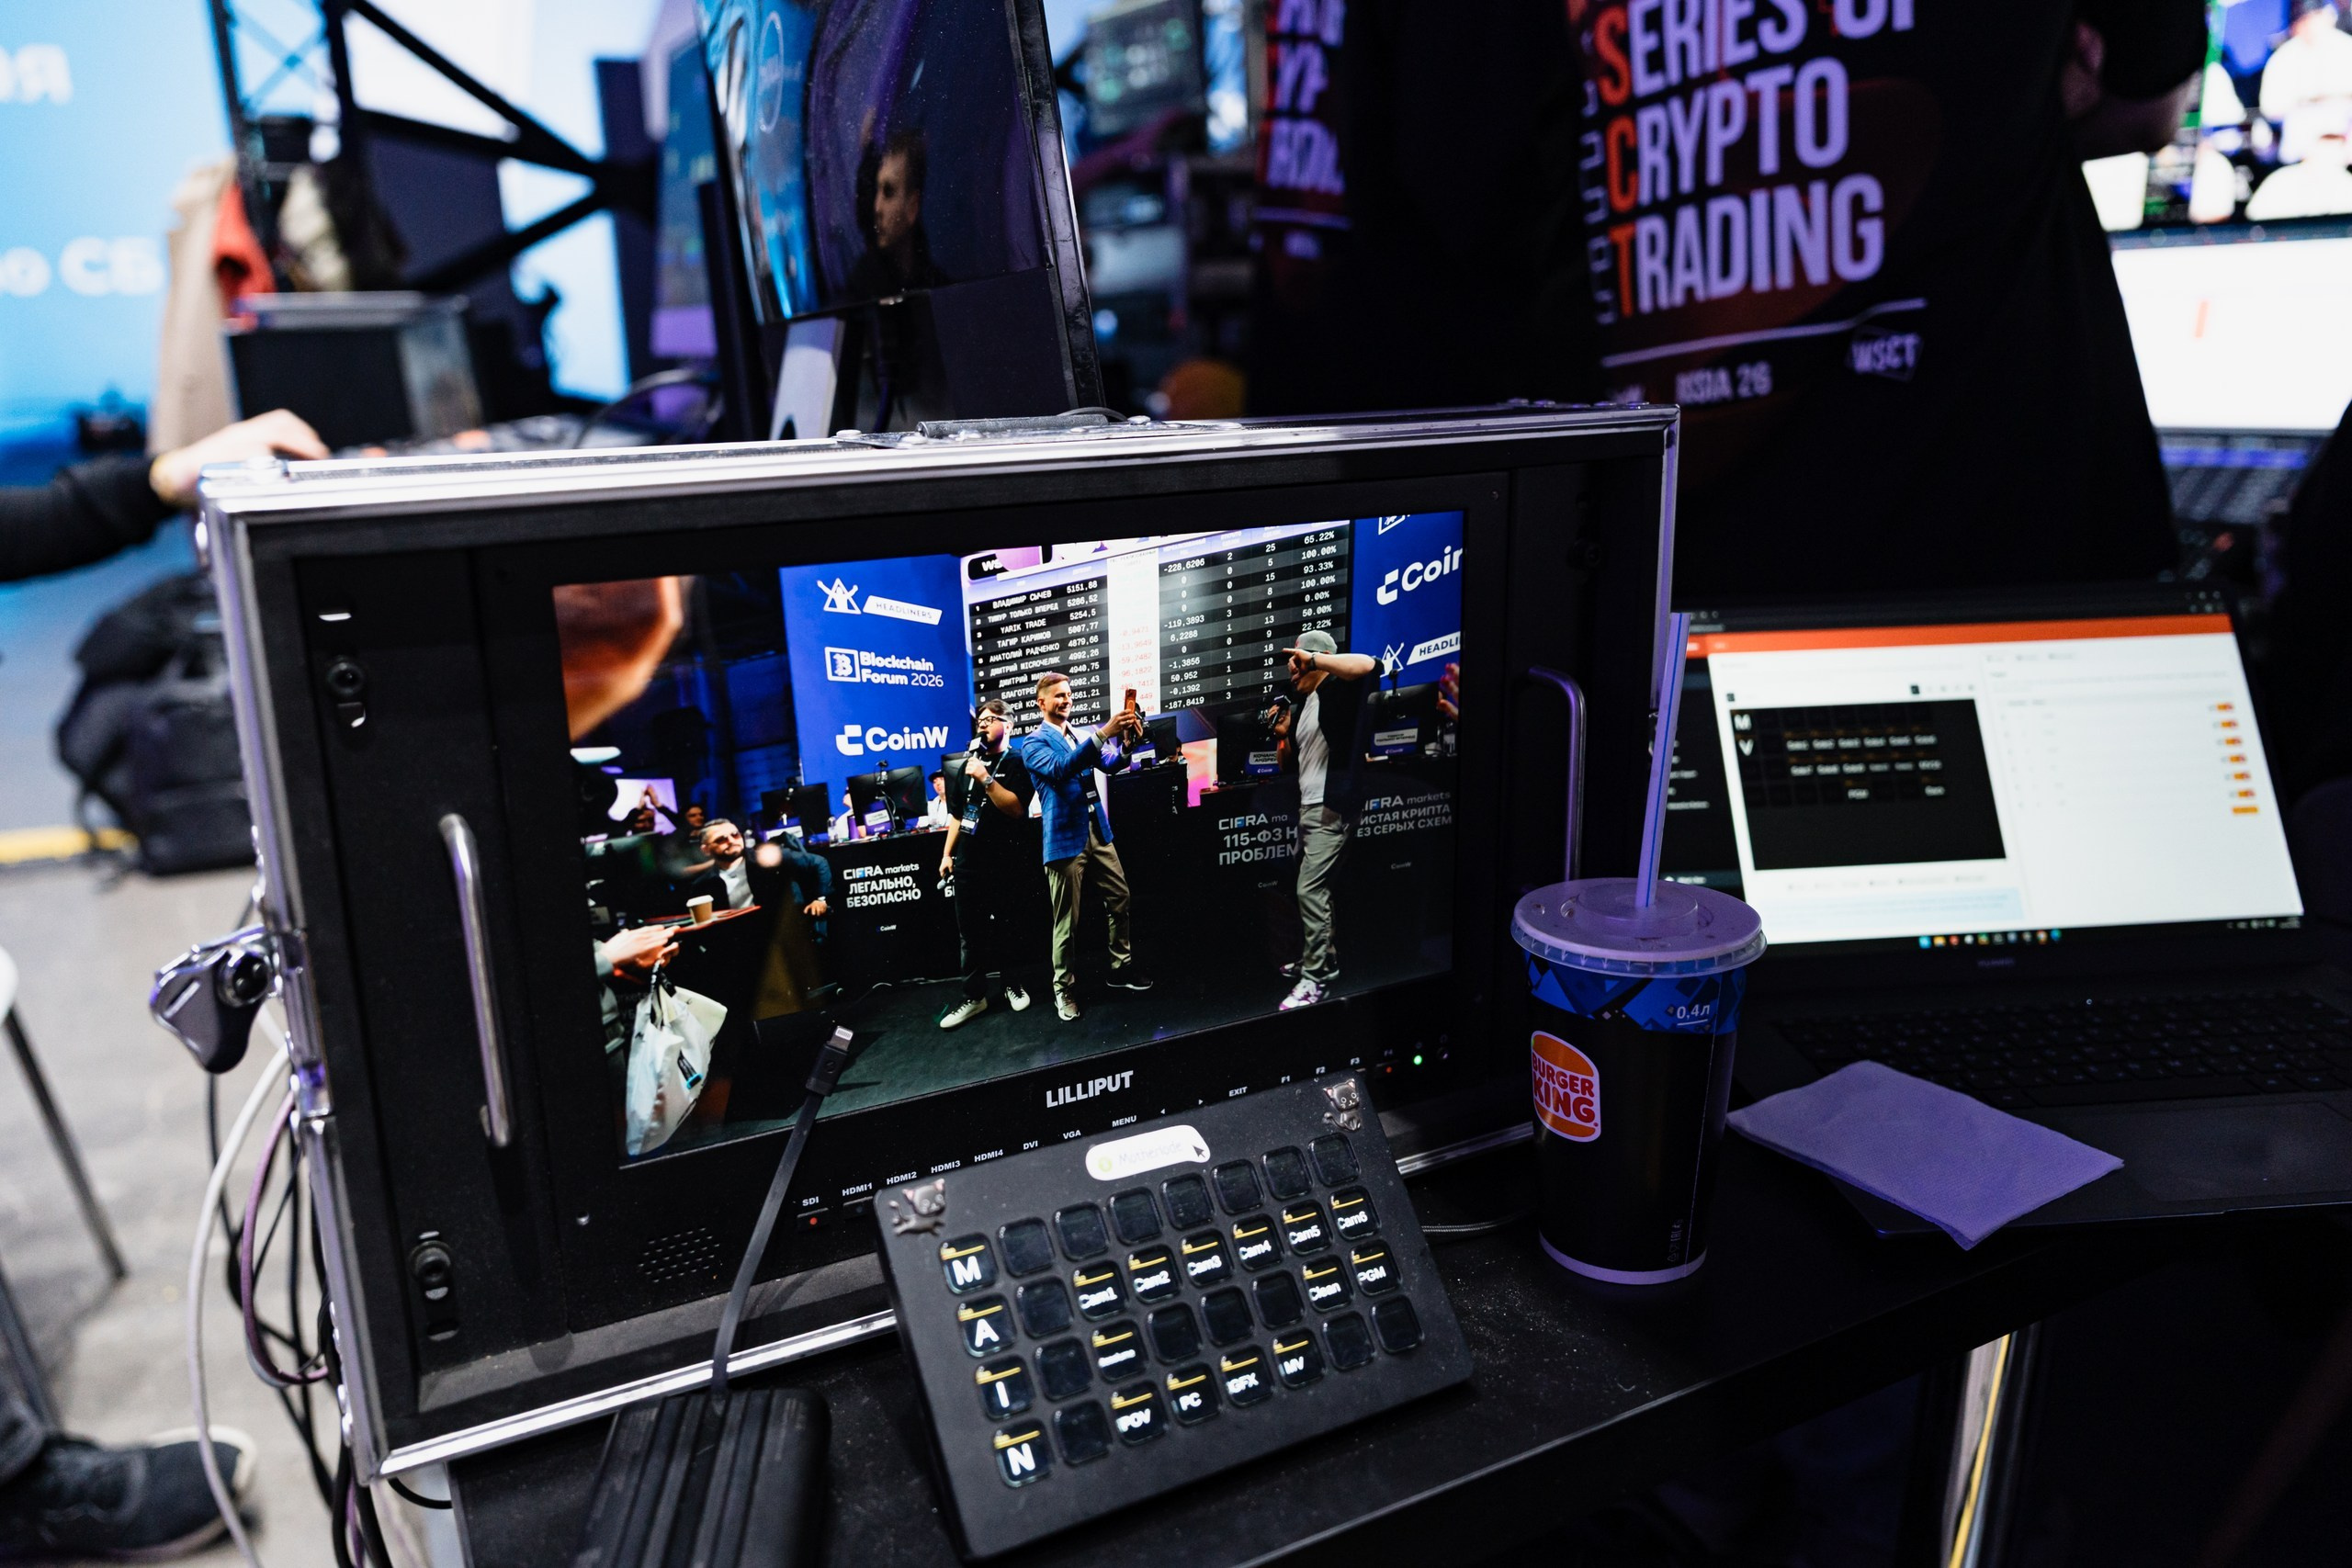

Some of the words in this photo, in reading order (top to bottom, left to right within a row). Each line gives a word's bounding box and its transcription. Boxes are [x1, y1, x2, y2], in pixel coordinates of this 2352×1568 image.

[1604, 57, 1849, 213] CRYPTO
[1608, 173, 1885, 317] TRADING
[1265, 543, 1276, 553] 25
[1304, 530, 1335, 545] 65.22%
[1301, 545, 1337, 560] 100.00%
[1300, 574, 1336, 590] 100.00%
[1024, 618, 1046, 629] TRADE
[1069, 608, 1096, 621] 5254,5
[1265, 572, 1275, 582] 15
[1303, 560, 1334, 574] 93.33%
[876, 602, 933, 620] HEADLINERS
[989, 649, 1023, 663] АНАТОЛИЙ
[1025, 643, 1060, 656] РАДЧЕНКО
[1068, 635, 1099, 648] 4879,66
[1164, 615, 1204, 629] -119,3893
[1305, 591, 1330, 603] 0.00%
[1069, 648, 1099, 661] 4992,26
[1170, 629, 1198, 641] 6,2288
[1264, 615, 1275, 625] 13
[1302, 604, 1332, 617] 50.00%
[1069, 661, 1100, 674] 4940,75
[1302, 618, 1332, 632] 22.22%
[860, 650, 934, 672] Blockchain
[1169, 657, 1201, 670] -1,3856
[1263, 644, 1274, 652] 18
[861, 669, 908, 686] Forum
[910, 673, 944, 688] 2026
[1170, 671, 1198, 682] 50,952
[1263, 658, 1273, 666] 10
[1170, 683, 1201, 695] -0,1392
[1263, 671, 1273, 680] 21
[1070, 714, 1101, 726] 4145,14
[1164, 696, 1204, 710] -187,8419
[1262, 684, 1273, 694] 17
[1734, 714, 1752, 732] M
[865, 726, 949, 752] CoinW
[1738, 739, 1754, 757] V
[1362, 795, 1404, 812] IFRA
[1407, 791, 1452, 805] markets
[1218, 813, 1268, 831] CIFRA
[1272, 814, 1288, 823] ma
[1360, 810, 1401, 826] ИСТАЯ
[1402, 804, 1452, 820] КРИПТА
[1357, 827, 1374, 838] ЕЗ
[1374, 821, 1415, 836] СЕРЫХ
[1418, 815, 1453, 829] СХЕМ
[843, 864, 884, 880] CIFRA
[885, 863, 920, 874] markets
[849, 875, 917, 895] ЛЕГАЛЬНО,
[846, 888, 922, 908] БЕЗОПАСНО
[1316, 1066, 1326, 1075] F2
[1351, 1056, 1360, 1066] F3
[1281, 1075, 1291, 1084] F1
[1532, 1052, 1595, 1098] BURGER
[1046, 1070, 1134, 1108] LILLIPUT
[1228, 1086, 1248, 1098] EXIT
[1533, 1071, 1596, 1123] KING
[1112, 1114, 1137, 1128] MENU
[1063, 1129, 1081, 1140] VGA
[974, 1148, 1004, 1163] HDMI4
[1023, 1140, 1038, 1151] DVI
[931, 1160, 961, 1174] HDMI3
[886, 1170, 917, 1186] HDMI2
[842, 1182, 873, 1197] HDMI1
[802, 1195, 820, 1207] SDI
[1337, 1211, 1368, 1230] Cam6
[1289, 1225, 1321, 1245] Cam5
[1238, 1240, 1272, 1260] Cam4
[952, 1256, 982, 1286] M
[1187, 1255, 1222, 1276] Cam3
[1358, 1266, 1386, 1285] PGM
[1134, 1270, 1171, 1293] Cam2
[1079, 1287, 1118, 1311] Cam1
[1309, 1282, 1341, 1302] Clean
[975, 1318, 1000, 1348] A
[995, 1381, 1010, 1408] I
[1179, 1392, 1202, 1411] PC
[1116, 1408, 1151, 1433] POV
[1007, 1443, 1036, 1476] N
